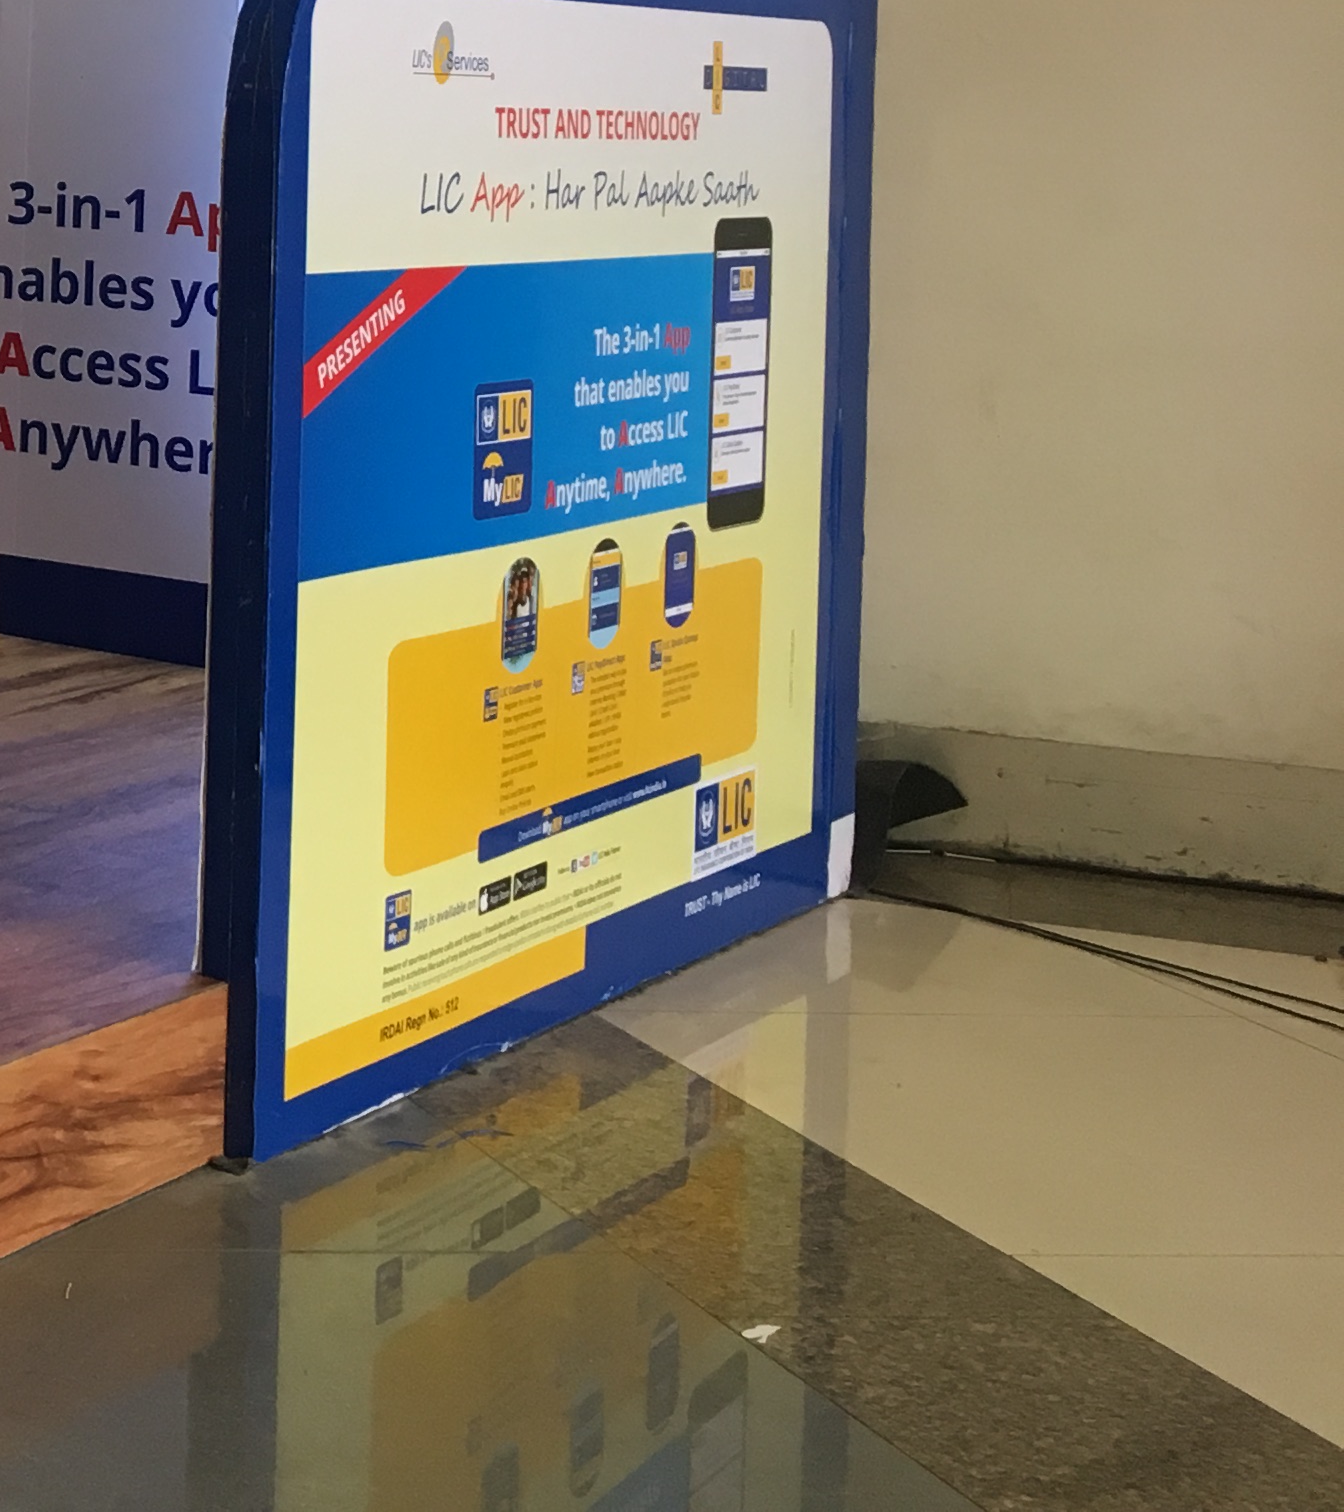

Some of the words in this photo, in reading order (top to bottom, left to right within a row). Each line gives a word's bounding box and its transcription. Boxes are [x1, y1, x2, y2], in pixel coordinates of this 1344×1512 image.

[495, 107, 550, 139] TRUST
[555, 109, 591, 139] AND
[596, 109, 701, 141] TECHNOLOGY
[7, 181, 149, 234] 3-in-1
[420, 172, 465, 215] LIC
[469, 174, 525, 223] App
[544, 169, 586, 211] Har
[593, 172, 630, 209] Pal
[635, 174, 699, 217] Aapke
[702, 170, 761, 209] Saath
[317, 289, 406, 388] PRESENTING
[594, 324, 620, 356] The
[623, 323, 661, 354] 3-in-1
[663, 324, 691, 352] App
[574, 379, 604, 408] that
[608, 373, 660, 402] enables
[663, 375, 690, 400] you
[499, 399, 529, 436] LIC
[600, 425, 615, 450] to
[618, 419, 664, 447] Access
[667, 412, 688, 439] LIC
[544, 475, 611, 514] Anytime,
[614, 464, 687, 497] Anywhere.
[722, 778, 752, 835] LIC
[436, 901, 466, 923] available
[684, 895, 708, 918] TRUST
[749, 872, 761, 890] LIC
[379, 1019, 403, 1042] IRDAI
[445, 995, 459, 1014] 512
